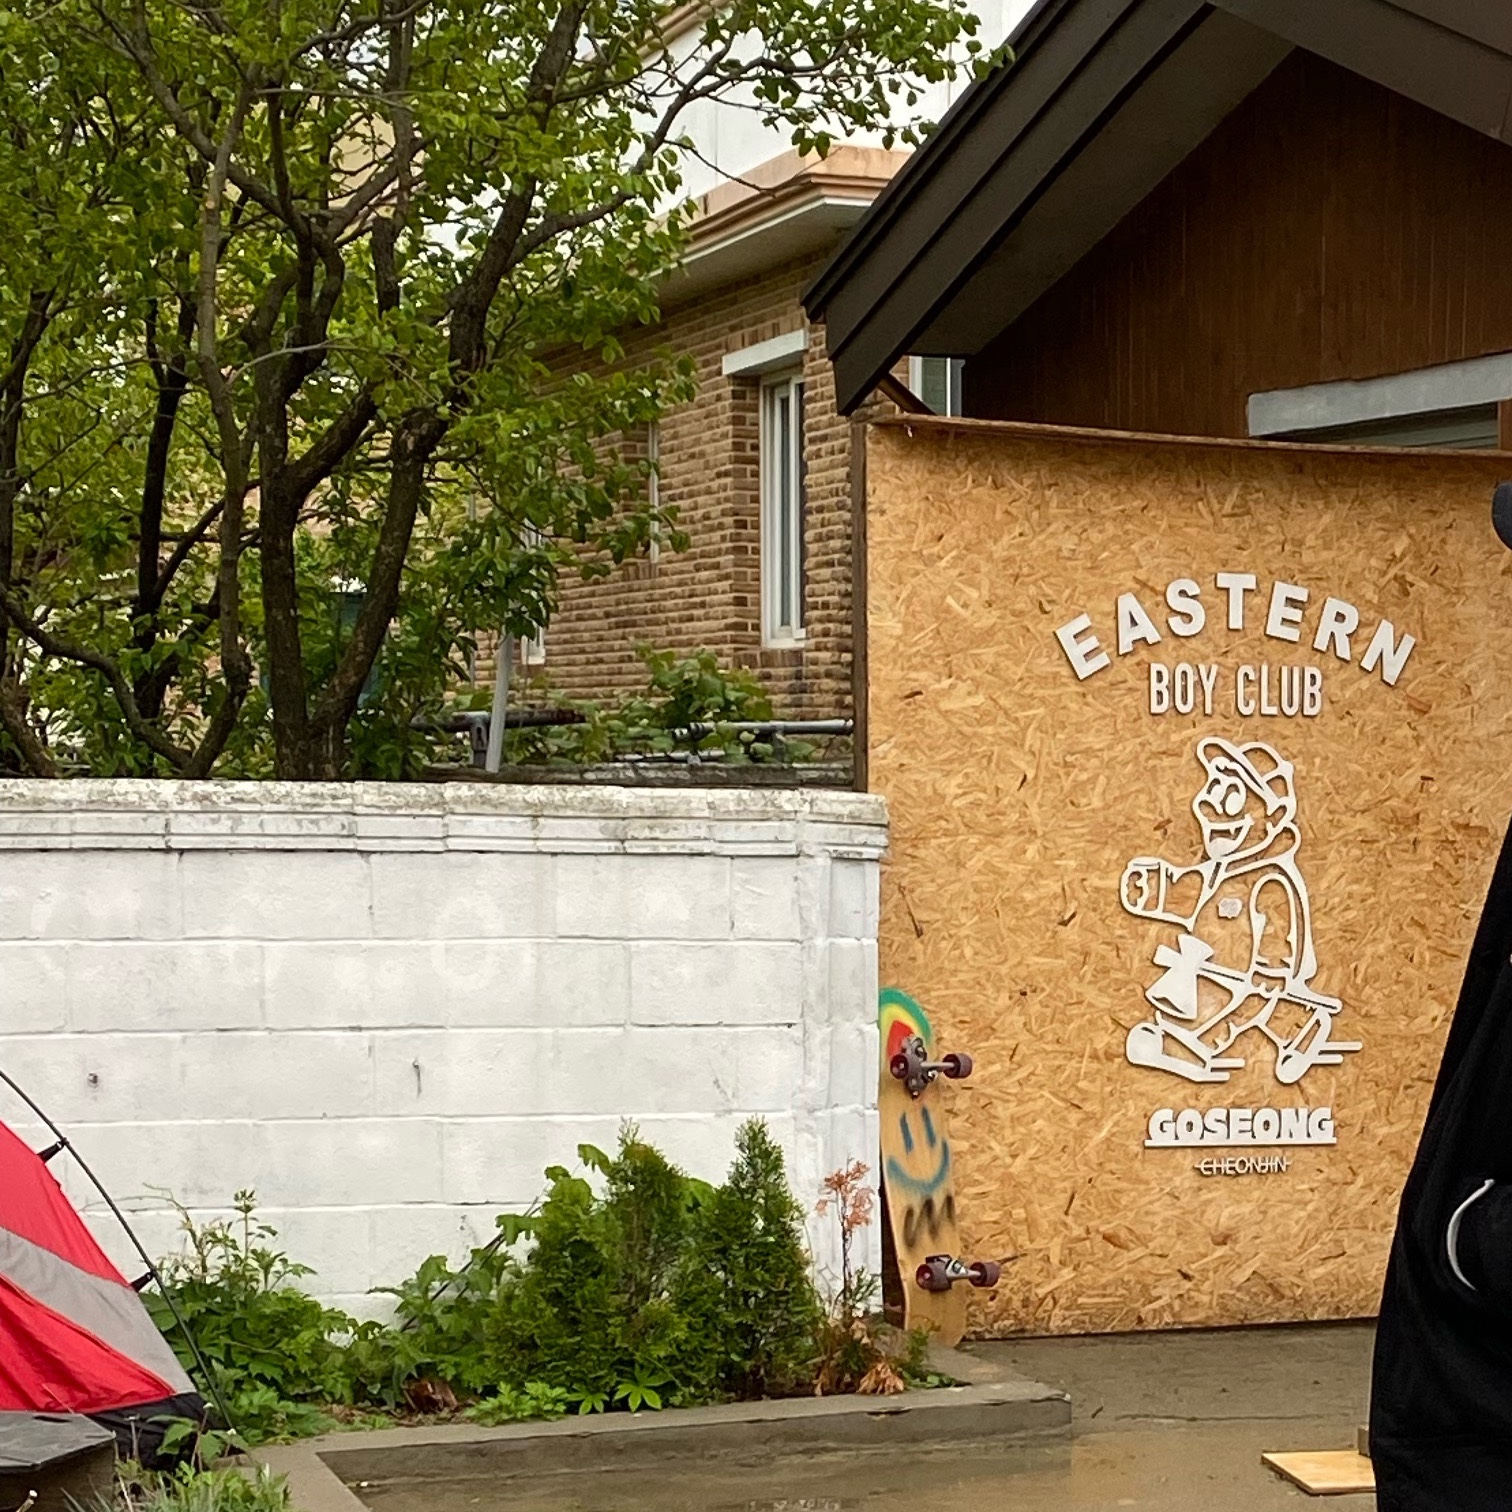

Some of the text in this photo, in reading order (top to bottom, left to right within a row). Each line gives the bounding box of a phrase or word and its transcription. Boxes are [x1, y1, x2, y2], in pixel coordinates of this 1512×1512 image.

[1053, 573, 1416, 686] EASTERN
[1150, 662, 1323, 716] BOY CLUB
[1146, 1106, 1336, 1145] GOSEONG
[1197, 1155, 1290, 1176] CHEONJIN
